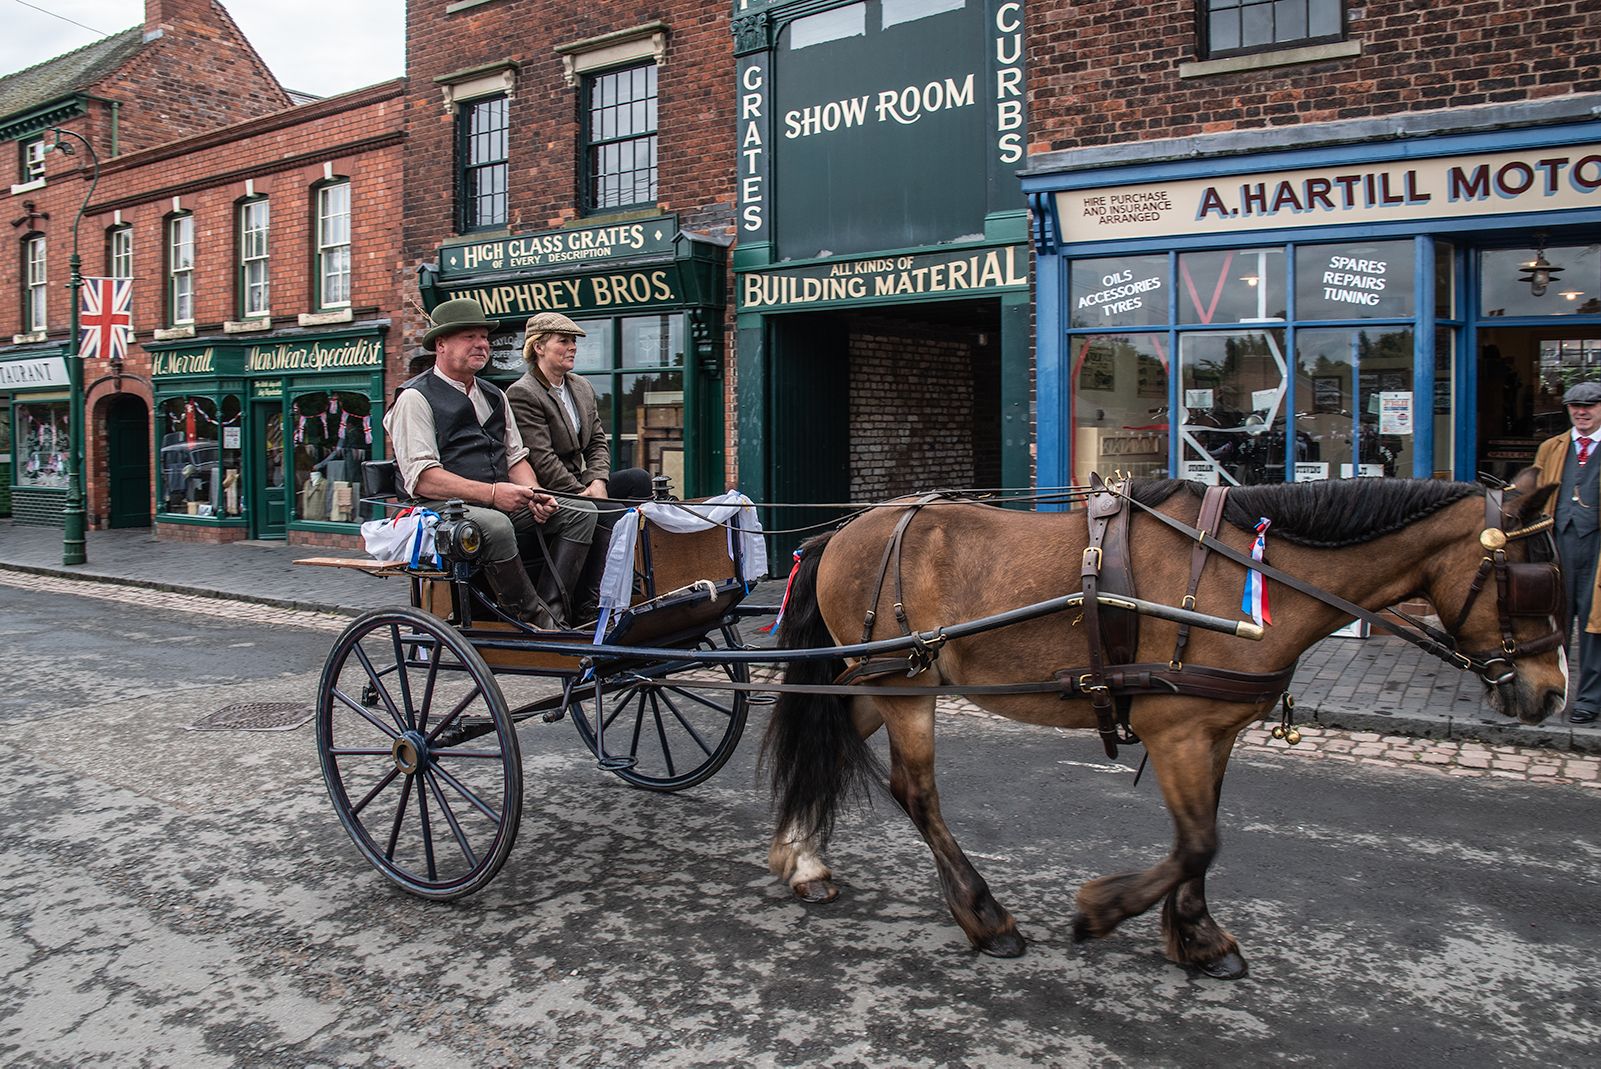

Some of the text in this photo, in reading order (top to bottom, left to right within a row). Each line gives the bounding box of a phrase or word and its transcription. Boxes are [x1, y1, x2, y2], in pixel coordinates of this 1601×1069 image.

[996, 3, 1023, 164] CURBS
[784, 73, 975, 139] SHOW ROOM
[742, 66, 763, 231] GRATES
[1083, 191, 1168, 207] HIRE PURCHASE
[1083, 201, 1172, 216] AND INSURANCE
[1099, 212, 1160, 224] ARRANGED
[464, 224, 645, 269] HIGH CLASS GRATES
[492, 247, 612, 269] OF EVERY DESCRIPTION
[830, 256, 915, 277] ALL KINDS OF
[1329, 255, 1387, 274] SPARES
[743, 246, 1028, 307] BUILDING MATERIAL
[1102, 269, 1133, 287] OILS
[1322, 271, 1386, 290] REPAIRS
[591, 271, 675, 306] BROS.
[1078, 277, 1161, 309] ACCESSORIES
[1323, 287, 1380, 306] TUNING
[1102, 297, 1142, 316] TYRES
